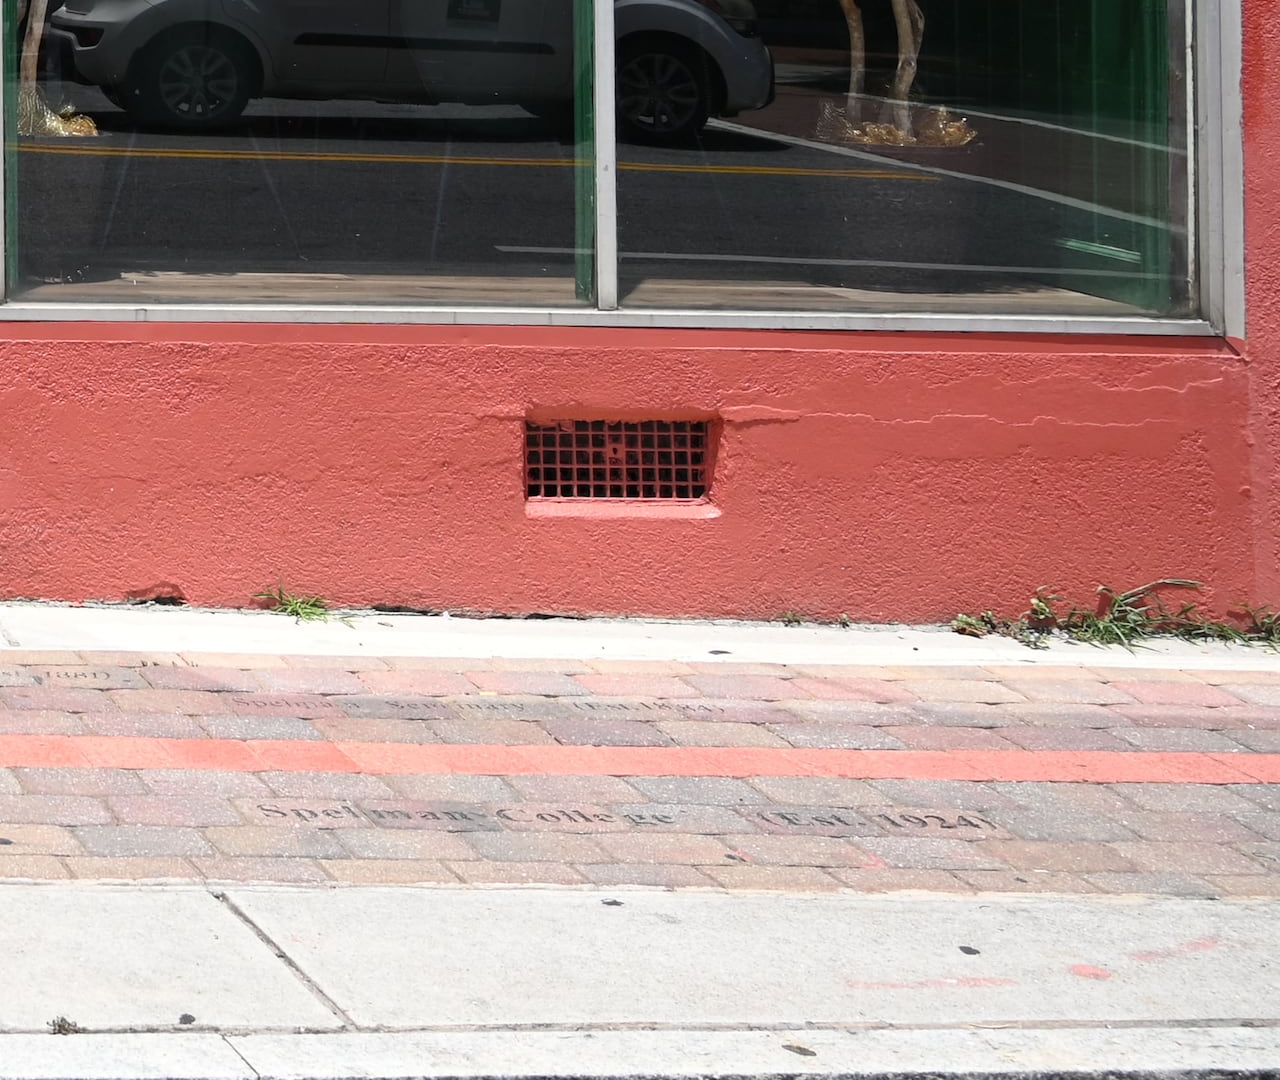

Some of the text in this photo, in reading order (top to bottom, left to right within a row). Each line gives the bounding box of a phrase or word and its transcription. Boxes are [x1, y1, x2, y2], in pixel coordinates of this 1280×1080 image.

[231, 695, 360, 709] Spelman
[256, 803, 480, 822] Spelman
[494, 807, 674, 827] College
[877, 813, 998, 830] 1924)
